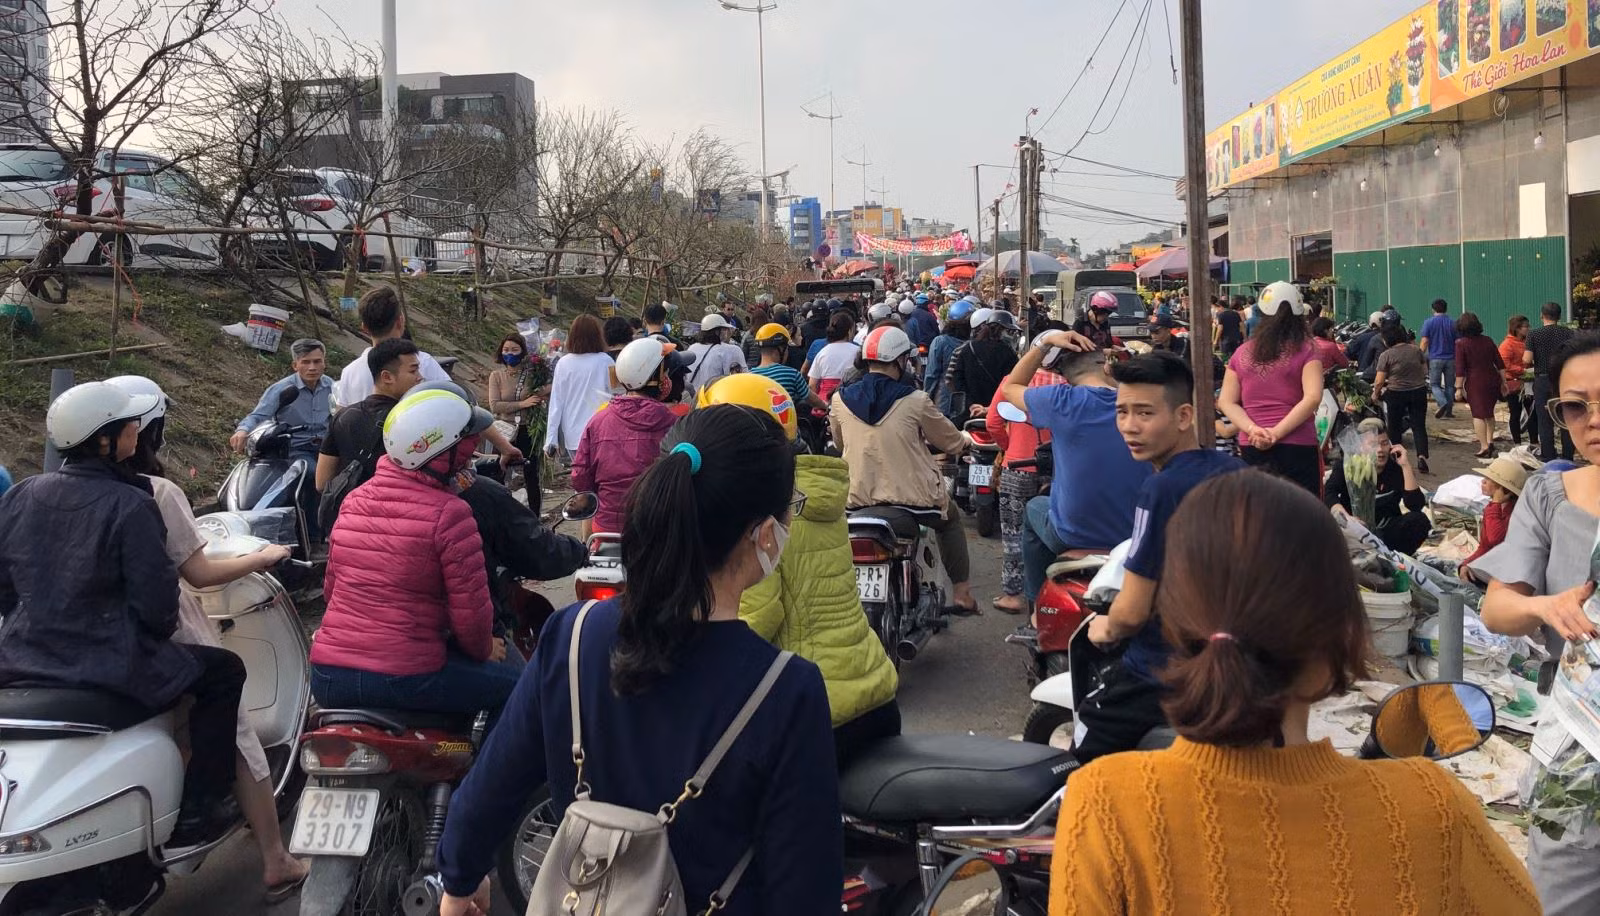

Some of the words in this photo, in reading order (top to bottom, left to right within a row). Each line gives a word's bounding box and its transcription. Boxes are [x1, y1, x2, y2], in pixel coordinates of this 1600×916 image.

[1348, 62, 1383, 102] XUÂN
[1463, 64, 1485, 92] Thế
[1485, 61, 1508, 90] Giới
[1512, 52, 1539, 73] Hoa
[308, 793, 368, 820] 29-N9
[303, 822, 363, 850] 3307
